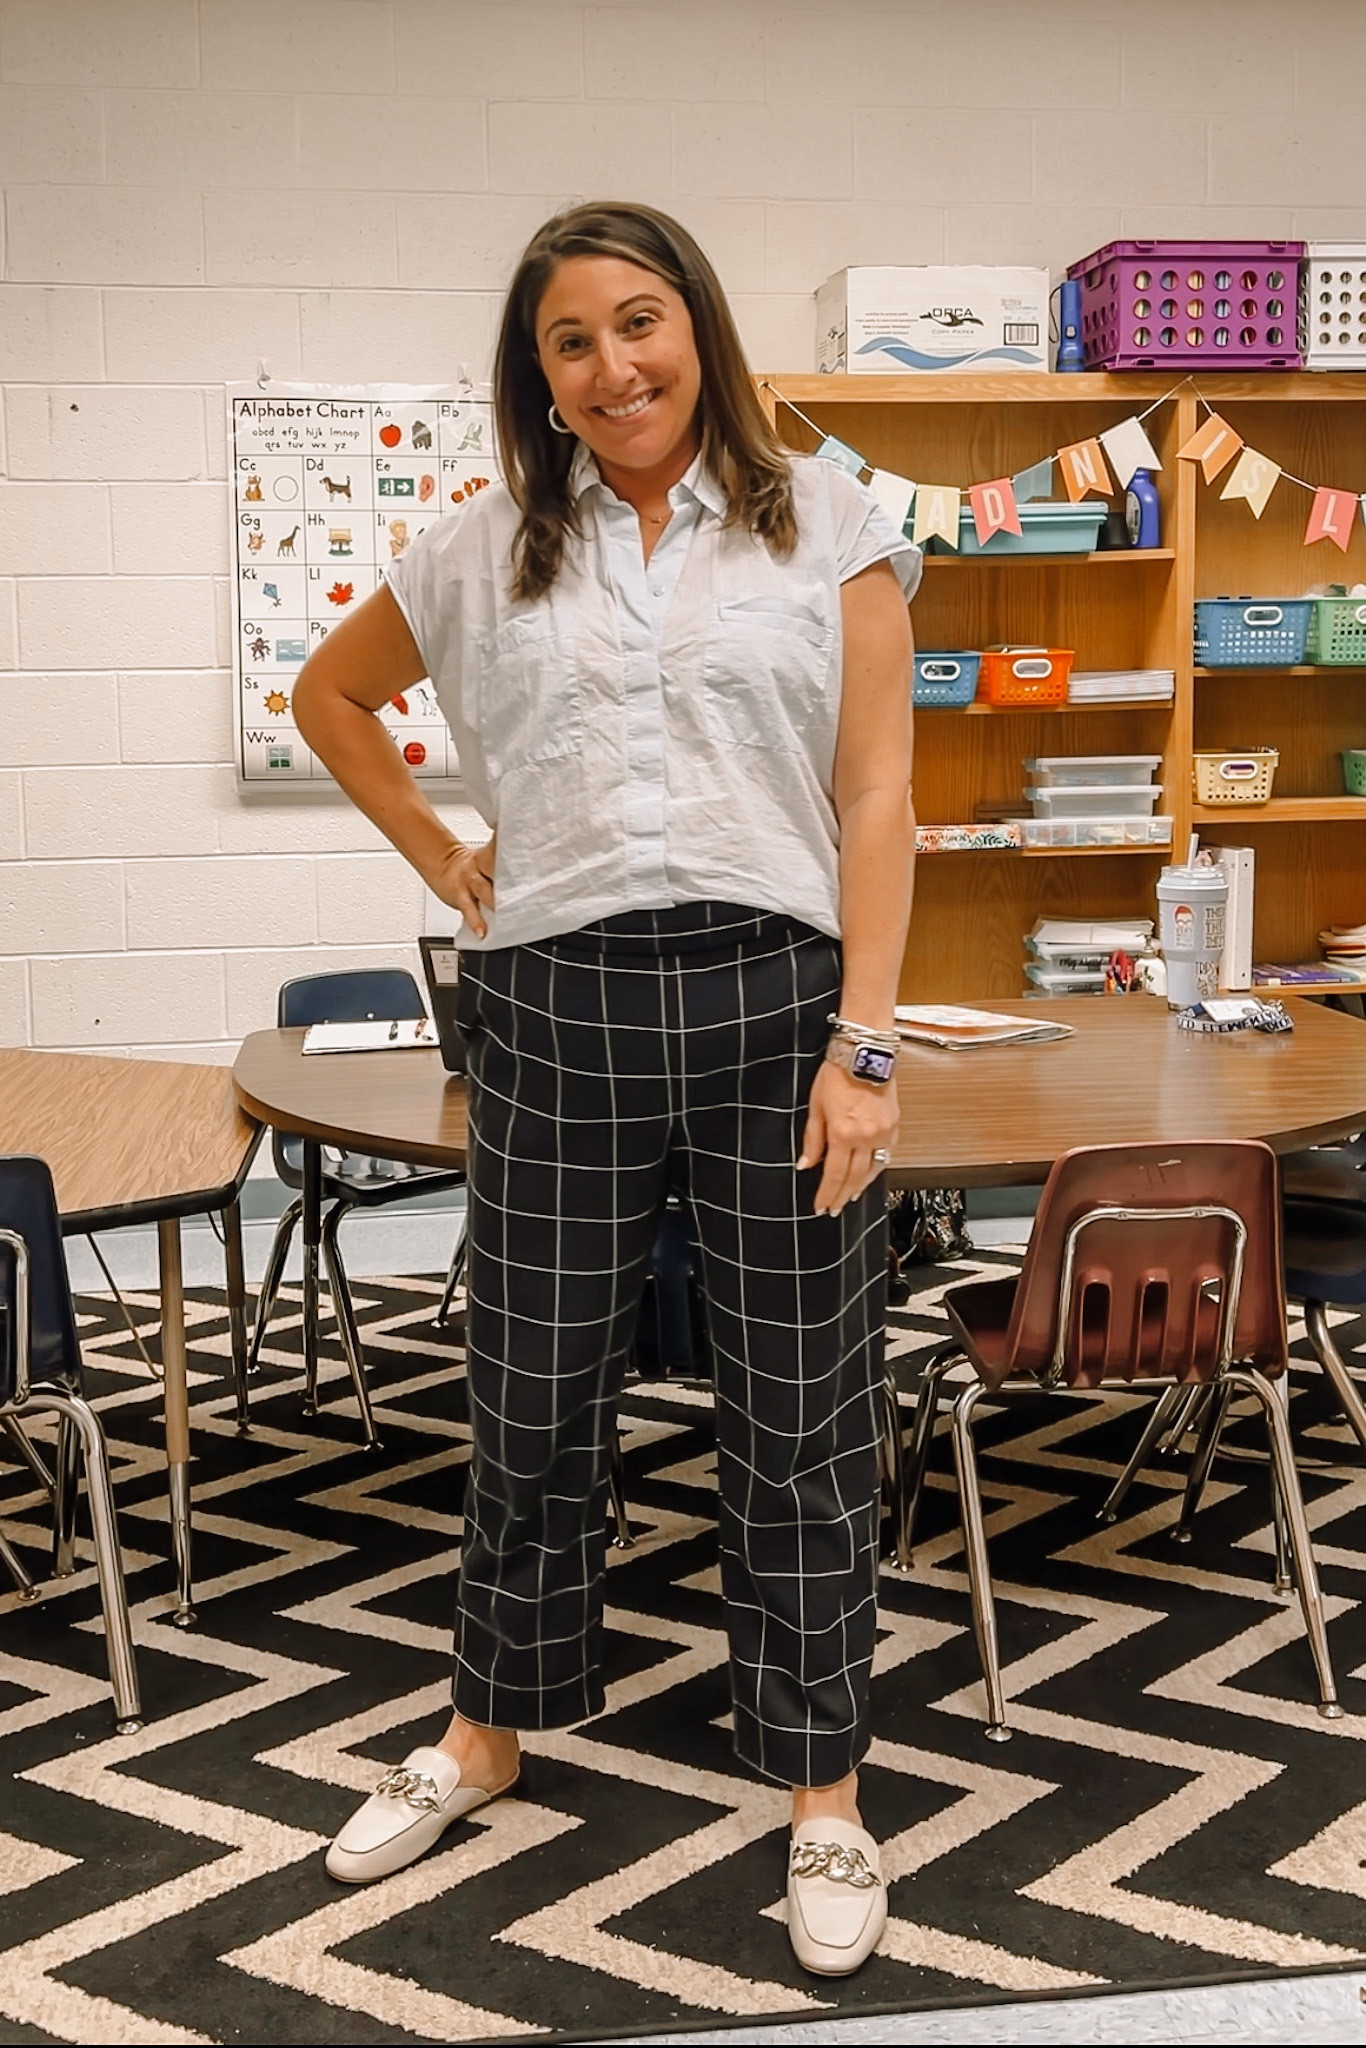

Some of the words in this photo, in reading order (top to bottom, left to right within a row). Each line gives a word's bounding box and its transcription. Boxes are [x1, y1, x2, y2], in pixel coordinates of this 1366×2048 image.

[932, 307, 974, 318] ORCA
[239, 401, 312, 423] Alphabet
[317, 402, 365, 419] Chart
[374, 407, 392, 418] Aa
[441, 406, 460, 417] Bb
[239, 459, 256, 471] Cc
[307, 459, 324, 471] Dd
[376, 460, 391, 472] Ee
[443, 460, 458, 472] Ff
[240, 514, 261, 530] Gg
[308, 514, 326, 526] Hh
[242, 568, 258, 580] Kk
[243, 623, 263, 635] Oo
[311, 622, 328, 639] Pp
[244, 678, 259, 689] Ss
[246, 732, 276, 743] Ww
